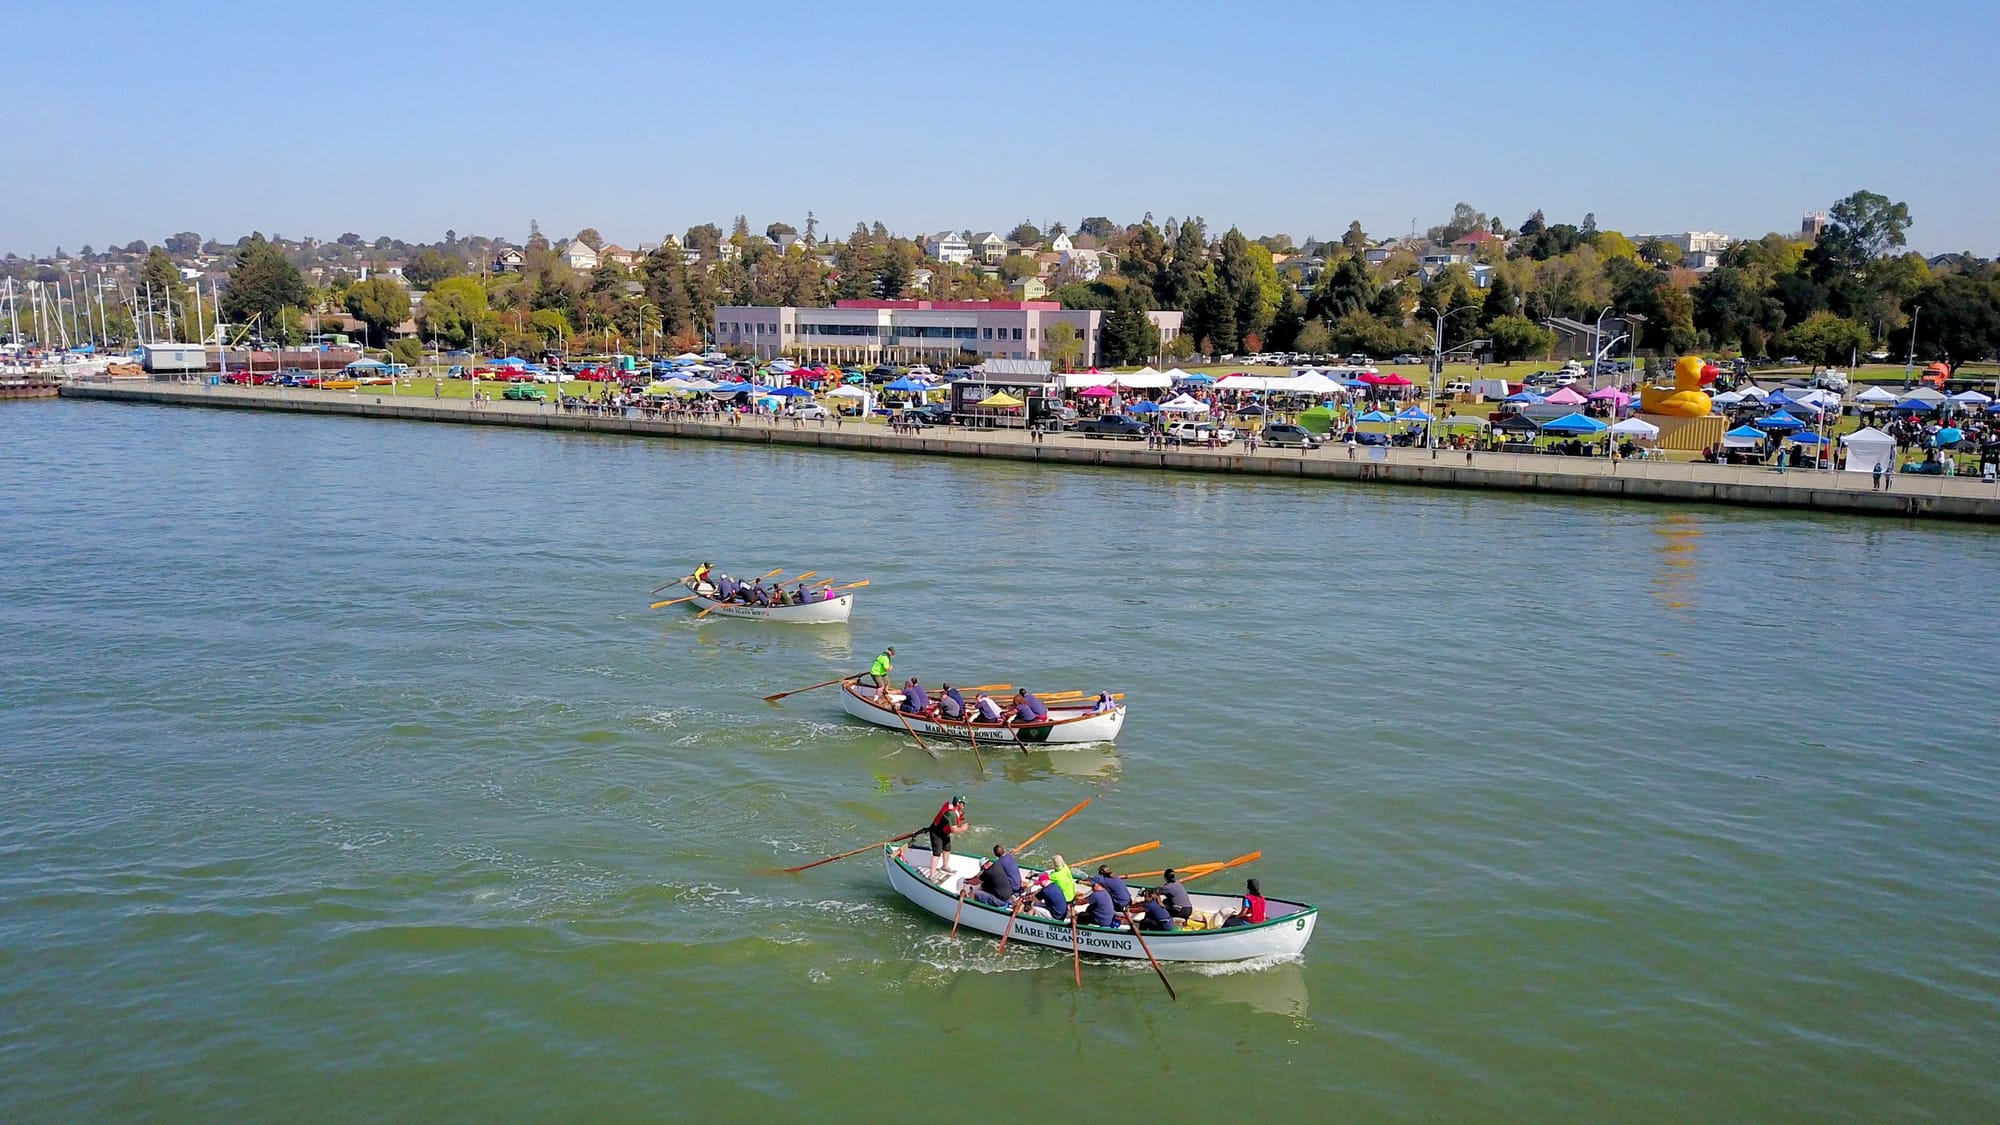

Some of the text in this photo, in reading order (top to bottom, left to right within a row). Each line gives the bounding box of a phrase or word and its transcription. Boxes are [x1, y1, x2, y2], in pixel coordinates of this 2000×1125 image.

[764, 375, 792, 388] OVE
[840, 598, 846, 606] 5
[1109, 712, 1116, 722] 4
[947, 728, 973, 737] ISLAN
[974, 730, 1004, 739] ROWING
[1295, 918, 1306, 931] 9
[1014, 923, 1132, 951] MARE ISLAND ROWING
[1048, 925, 1092, 938] STRAIS OF
